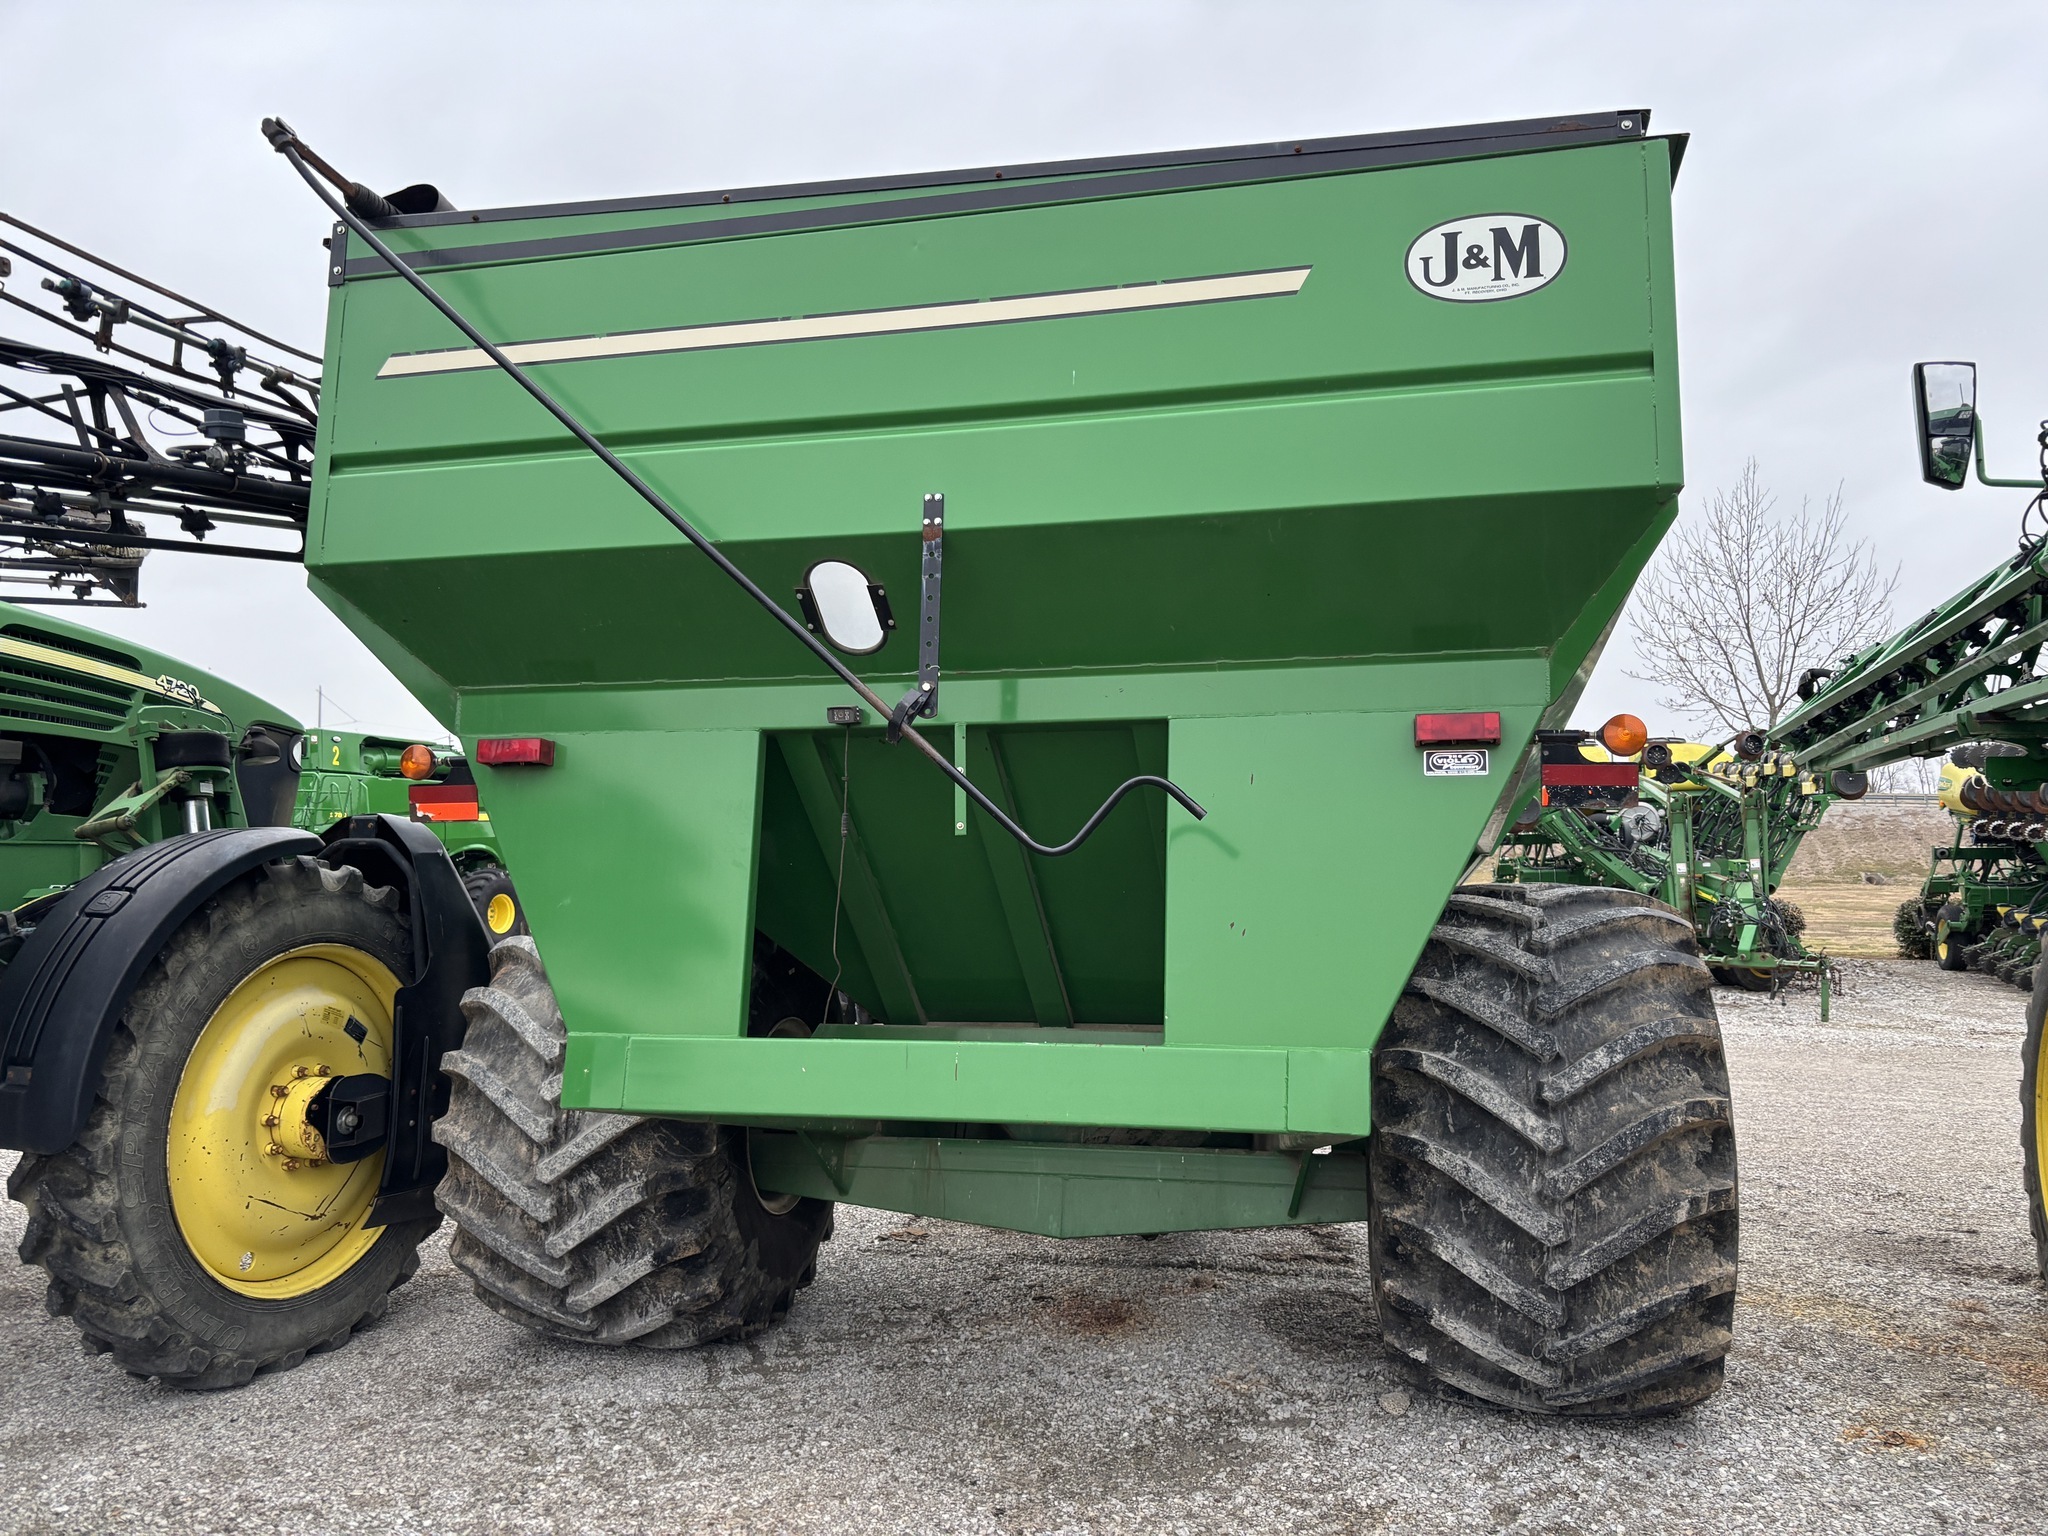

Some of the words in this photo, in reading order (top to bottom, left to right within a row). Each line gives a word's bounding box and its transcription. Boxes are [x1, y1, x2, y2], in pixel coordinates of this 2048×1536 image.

[1419, 223, 1544, 287] J&M
[156, 674, 200, 700] 4720
[332, 745, 340, 766] 2
